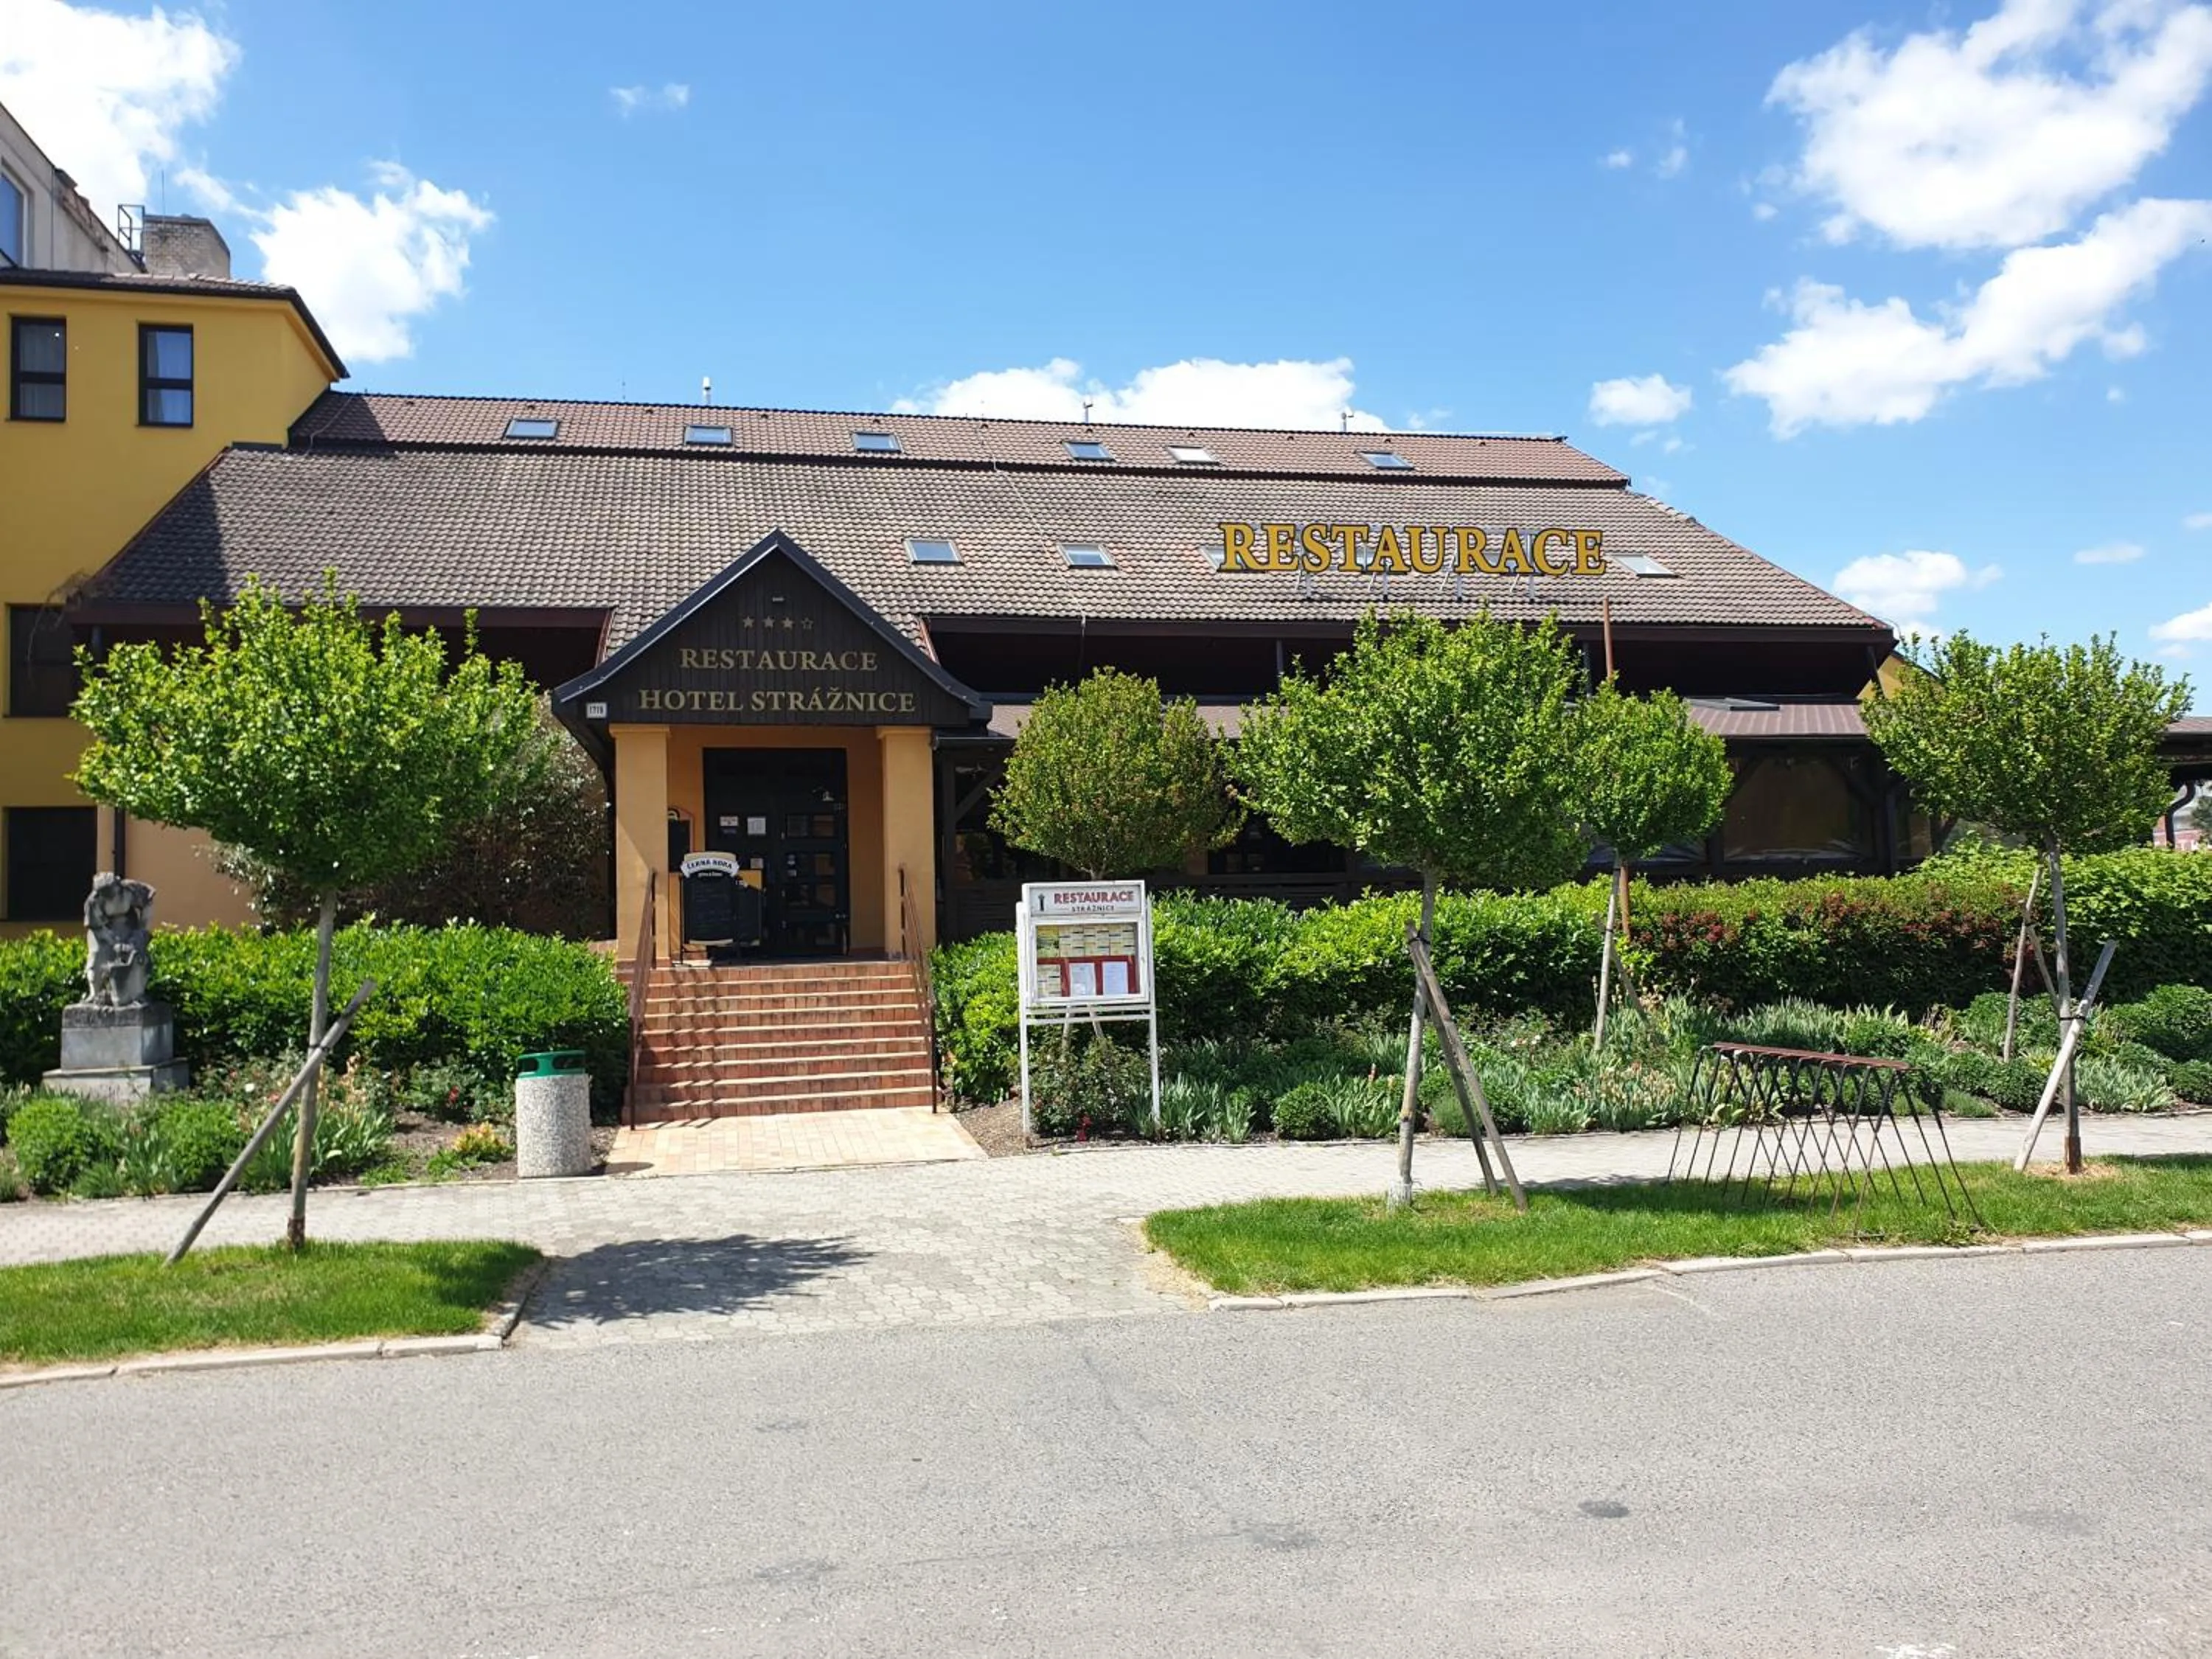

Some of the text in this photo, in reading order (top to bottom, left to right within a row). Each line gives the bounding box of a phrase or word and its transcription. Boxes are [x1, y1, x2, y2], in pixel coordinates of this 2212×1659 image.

[1217, 522, 1606, 576] RESTAURACE
[679, 647, 878, 672] RESTAURACE
[639, 684, 916, 712] HOTEL STRÁŽNICE
[1054, 891, 1133, 904] RESTAURACE
